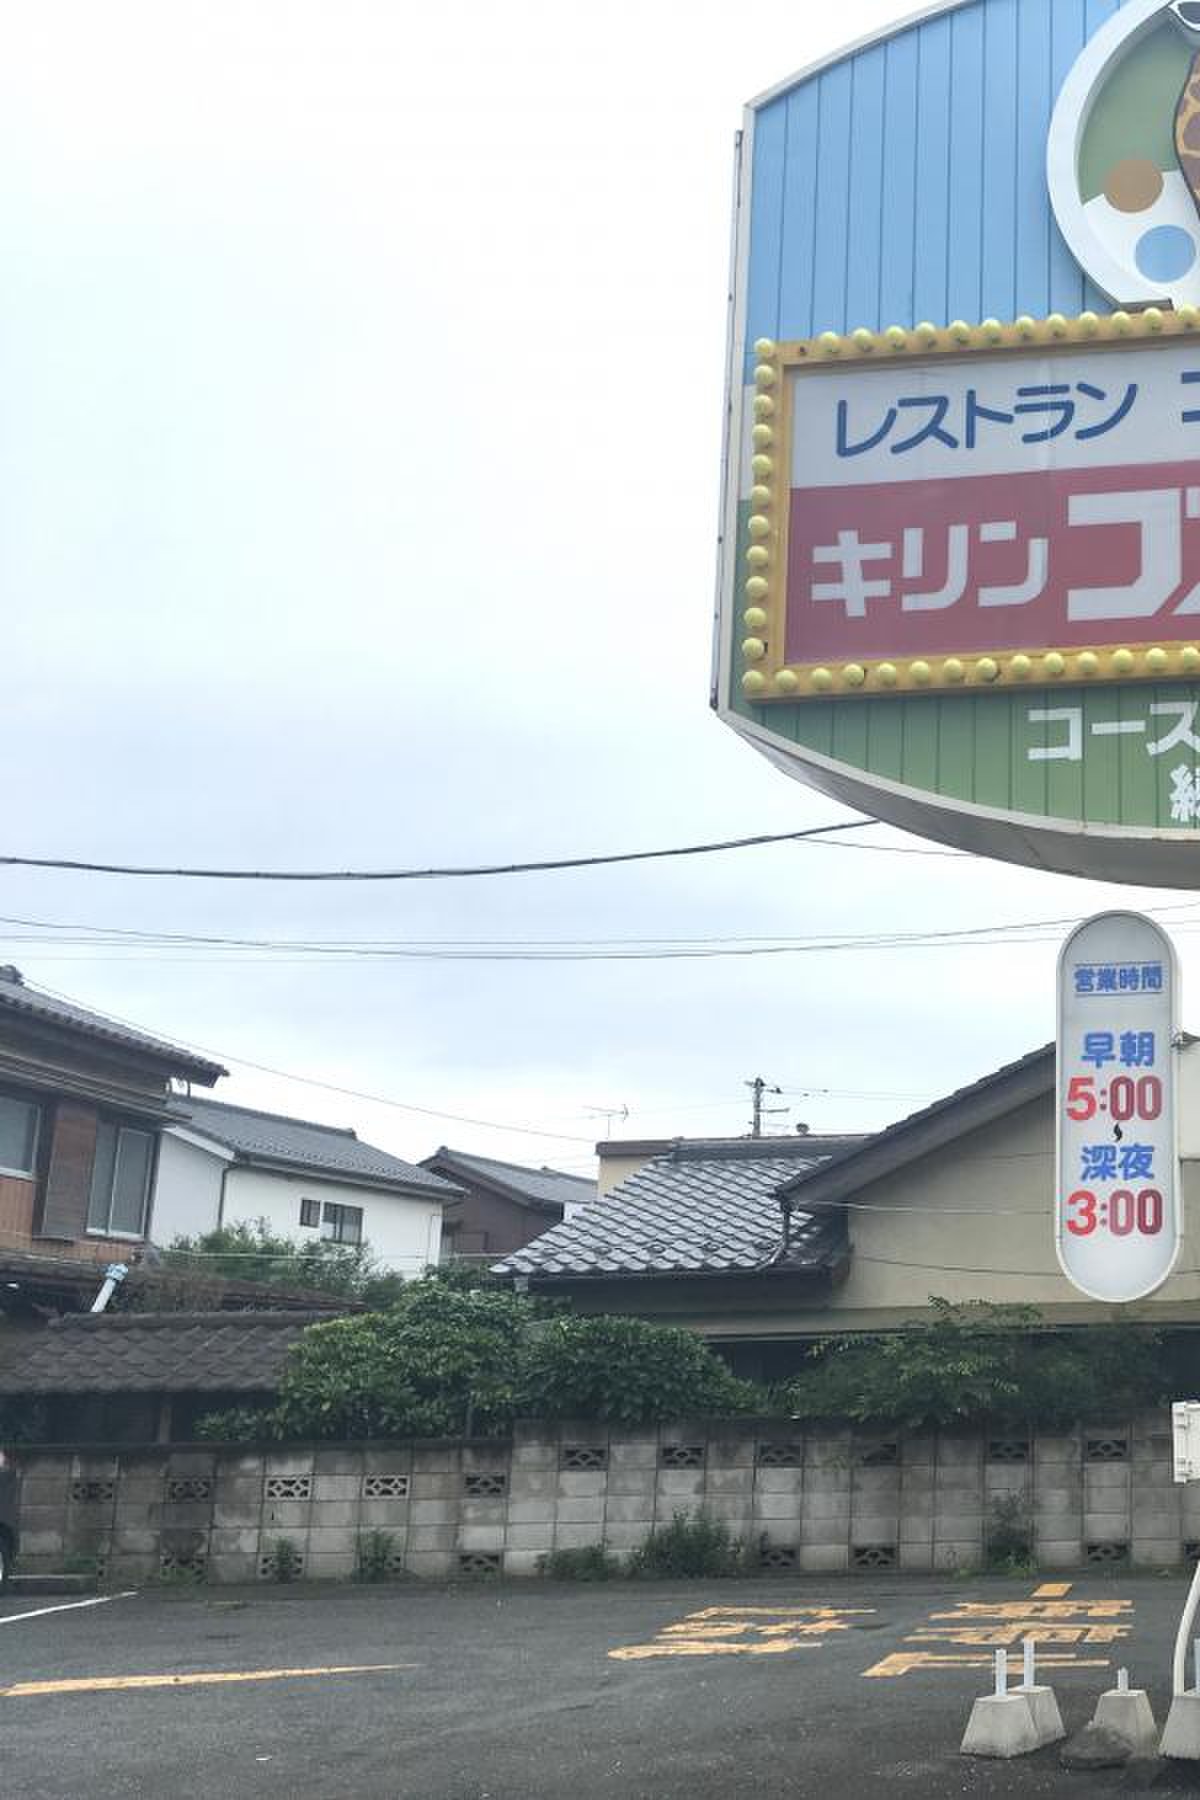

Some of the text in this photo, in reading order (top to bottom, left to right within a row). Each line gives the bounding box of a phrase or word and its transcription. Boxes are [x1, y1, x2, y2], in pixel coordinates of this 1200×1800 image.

[834, 382, 1138, 458] レストラン
[1074, 965, 1164, 994] 営業時間
[1081, 1031, 1156, 1069] 早朝
[1066, 1075, 1164, 1122] 5:00
[1080, 1145, 1156, 1182] 深夜
[1066, 1188, 1164, 1238] 3:00
